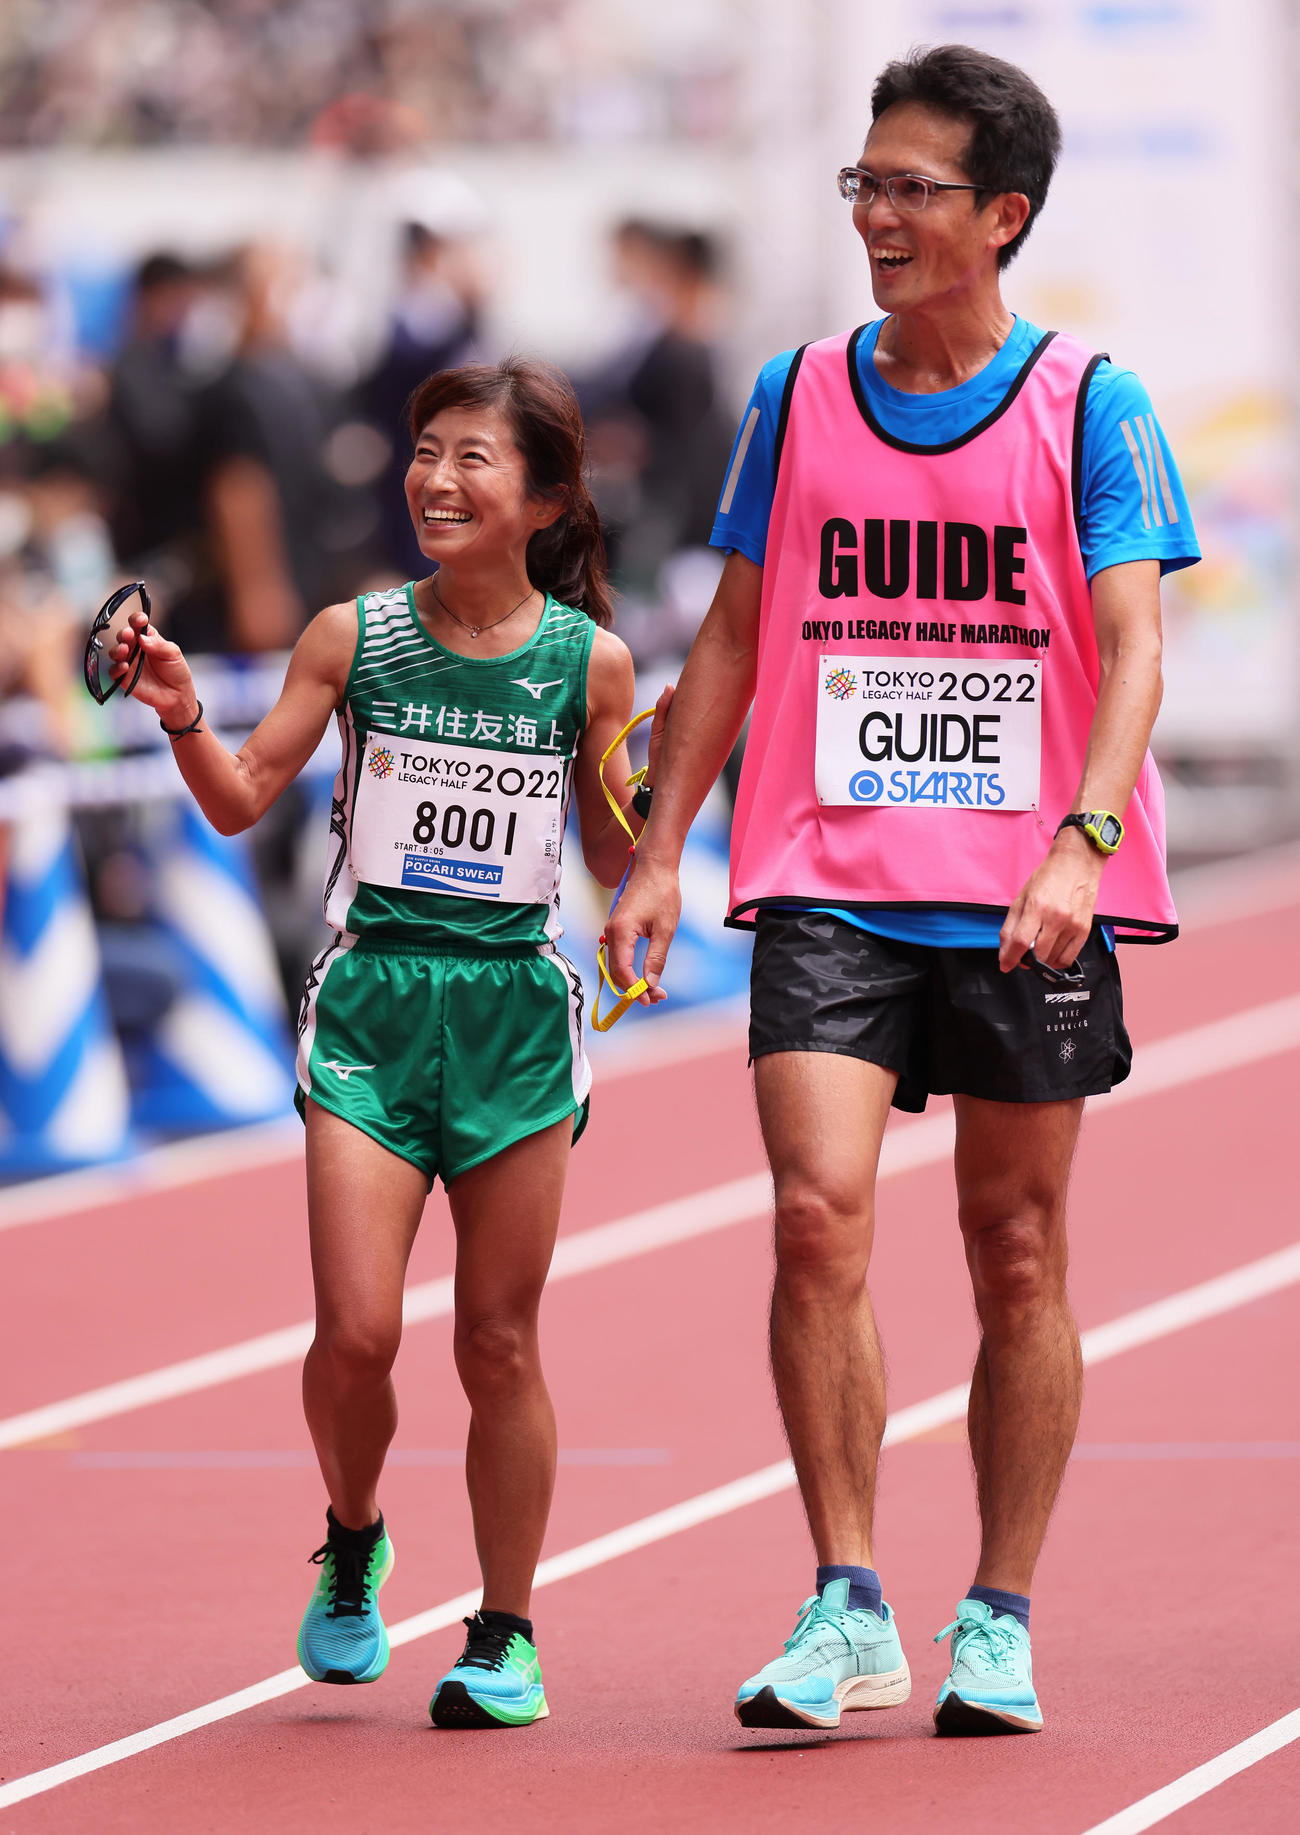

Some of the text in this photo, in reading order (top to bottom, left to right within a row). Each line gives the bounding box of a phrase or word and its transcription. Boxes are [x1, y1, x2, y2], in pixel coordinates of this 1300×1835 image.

[818, 517, 1028, 606] GUIDE
[802, 620, 1051, 649] OKYO LEGACY HALF MARATHON
[862, 671, 1035, 703] TOKYO 2022
[862, 690, 933, 700] LEGACY HALF
[370, 700, 564, 751] 三井住友海上
[858, 711, 1001, 764] GUIDE
[397, 772, 468, 790] LEGACY HALF
[400, 752, 560, 799] TOKYO 2022
[412, 801, 517, 856] 8001
[405, 860, 454, 876] POCARI
[456, 867, 502, 882] SWEAT
